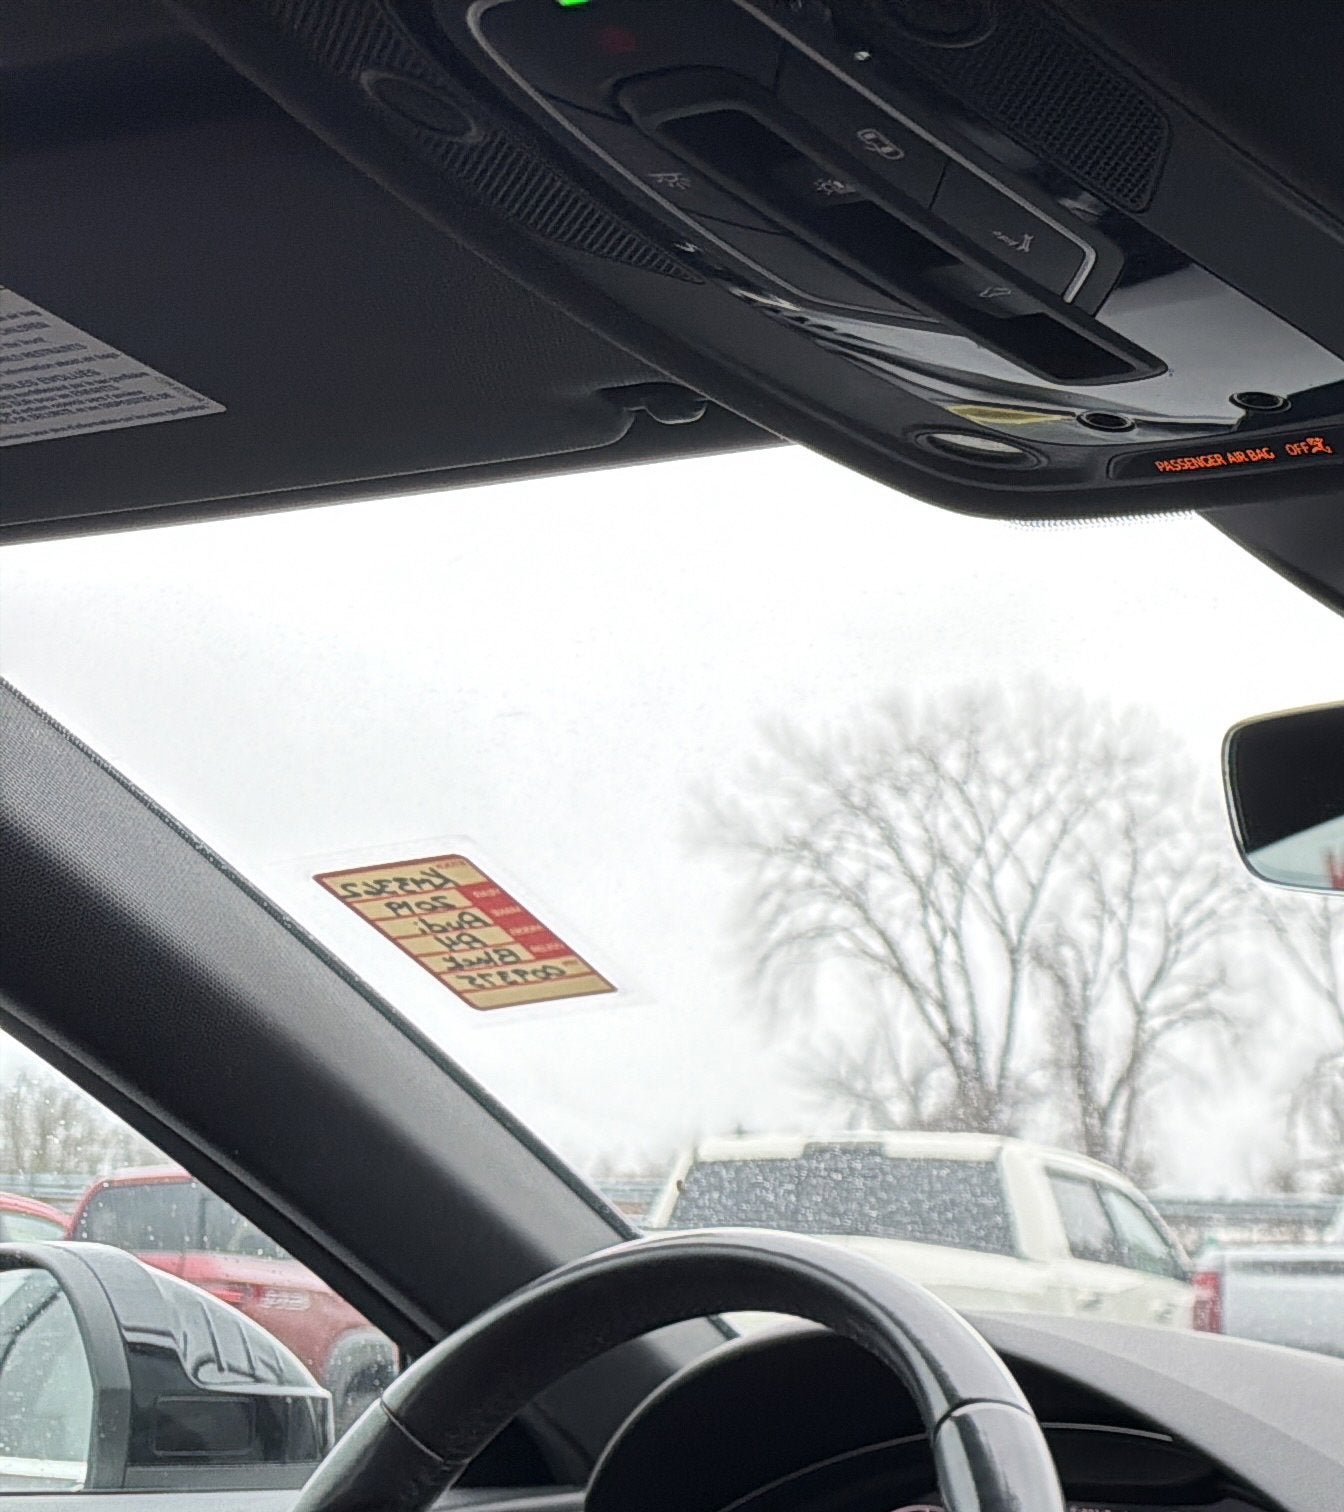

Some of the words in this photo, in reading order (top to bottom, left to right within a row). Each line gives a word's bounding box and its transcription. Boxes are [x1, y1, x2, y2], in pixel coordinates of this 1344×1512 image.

[1154, 453, 1227, 473] PASSENGER
[1226, 450, 1249, 465] AIR
[1247, 446, 1276, 462] BAG
[1285, 440, 1309, 457] OFF
